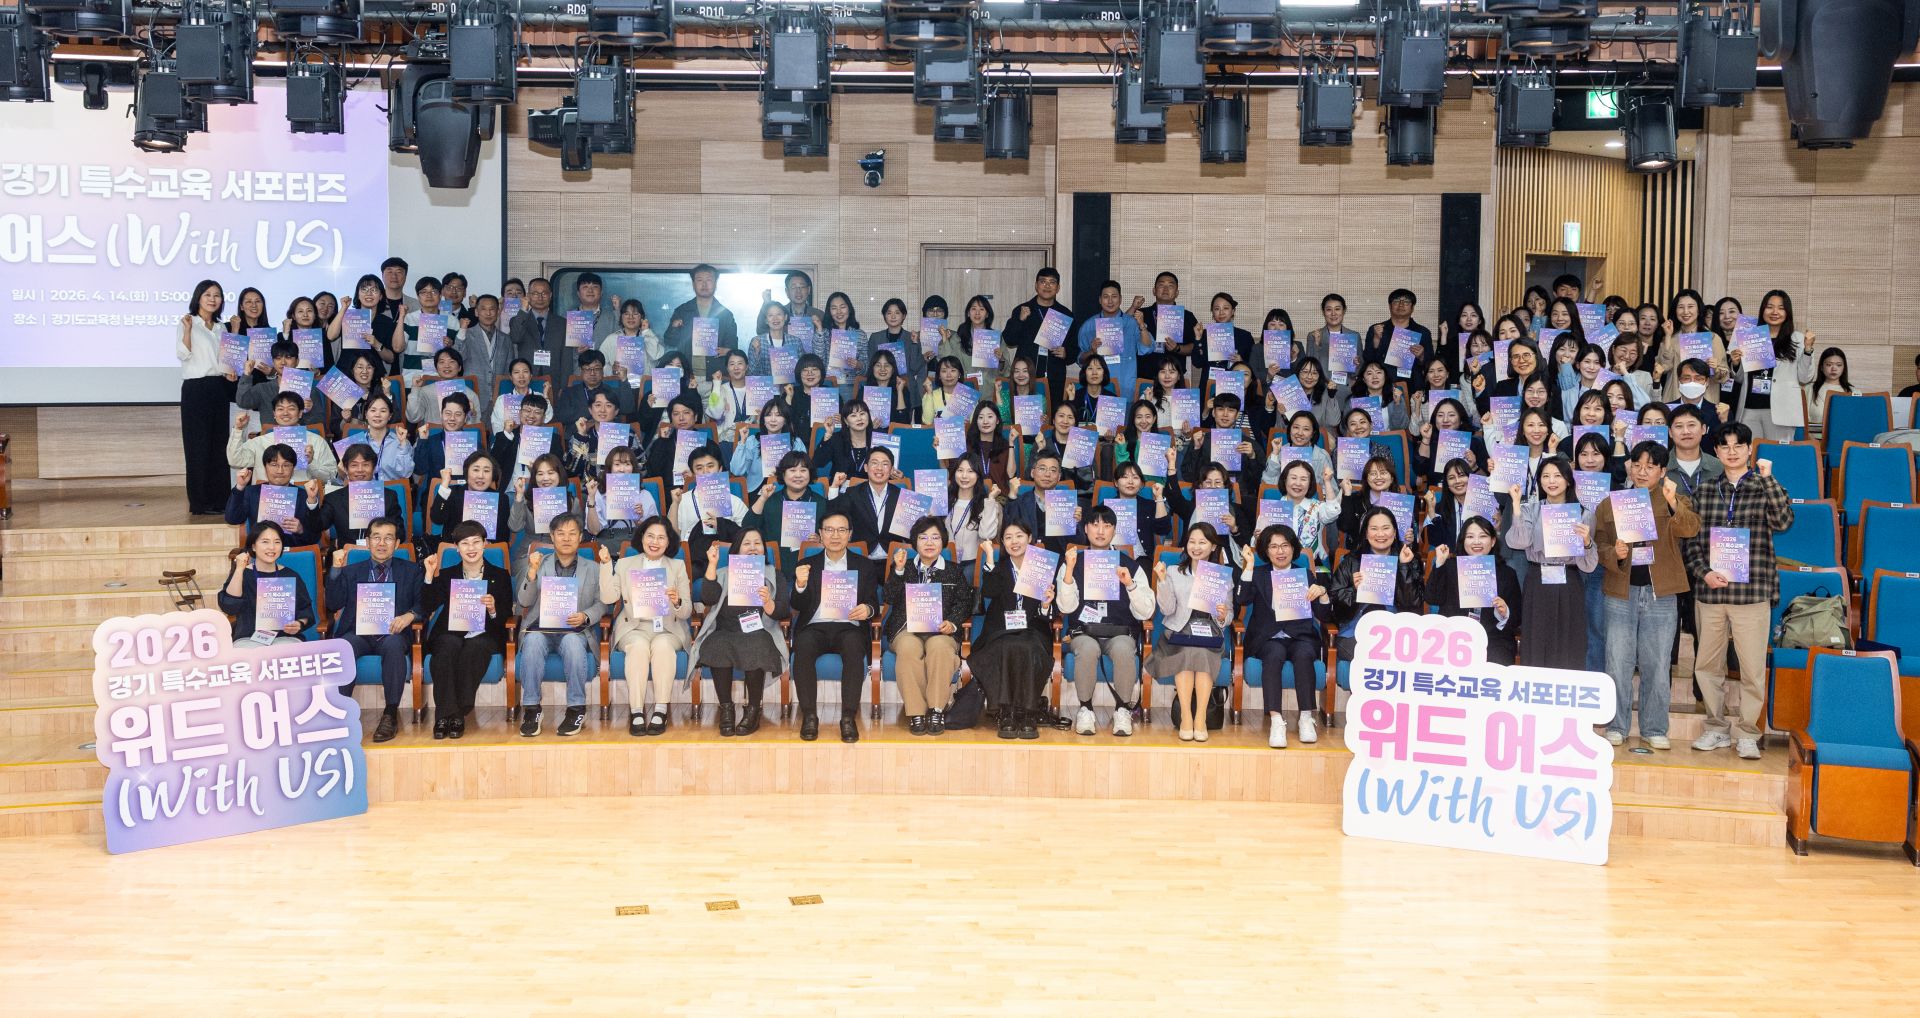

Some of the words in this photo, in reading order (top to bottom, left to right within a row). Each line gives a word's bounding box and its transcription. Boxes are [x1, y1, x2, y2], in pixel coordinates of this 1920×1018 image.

[567, 4, 587, 15] RD9
[699, 6, 724, 17] RD10
[1, 163, 69, 198] 경기
[79, 165, 213, 201] 특수교육
[221, 170, 348, 203] 서포터즈
[0, 213, 97, 264] 어스
[107, 211, 241, 272] (With
[256, 219, 344, 272] US)
[12, 289, 36, 302] 일시
[50, 289, 89, 302] 2026.
[92, 290, 105, 302] 4.
[13, 313, 37, 326] 장소
[52, 313, 121, 327] 경기도교육청
[108, 622, 219, 669] 2026
[1368, 625, 1473, 667] 2026
[108, 674, 156, 700] 경기
[161, 661, 252, 693] 특수교육
[258, 652, 344, 682] 서포터즈
[1363, 668, 1406, 693] 경기
[1412, 672, 1501, 702] 특수교육
[1508, 680, 1601, 709] 서포터즈
[109, 697, 229, 768] 위드
[240, 683, 350, 750] 어스
[1358, 699, 1467, 767] 위드
[1484, 710, 1599, 780] 어스
[118, 758, 265, 828] (With
[278, 747, 355, 800] US)
[1357, 768, 1496, 838] (With
[1515, 783, 1598, 841] US)
